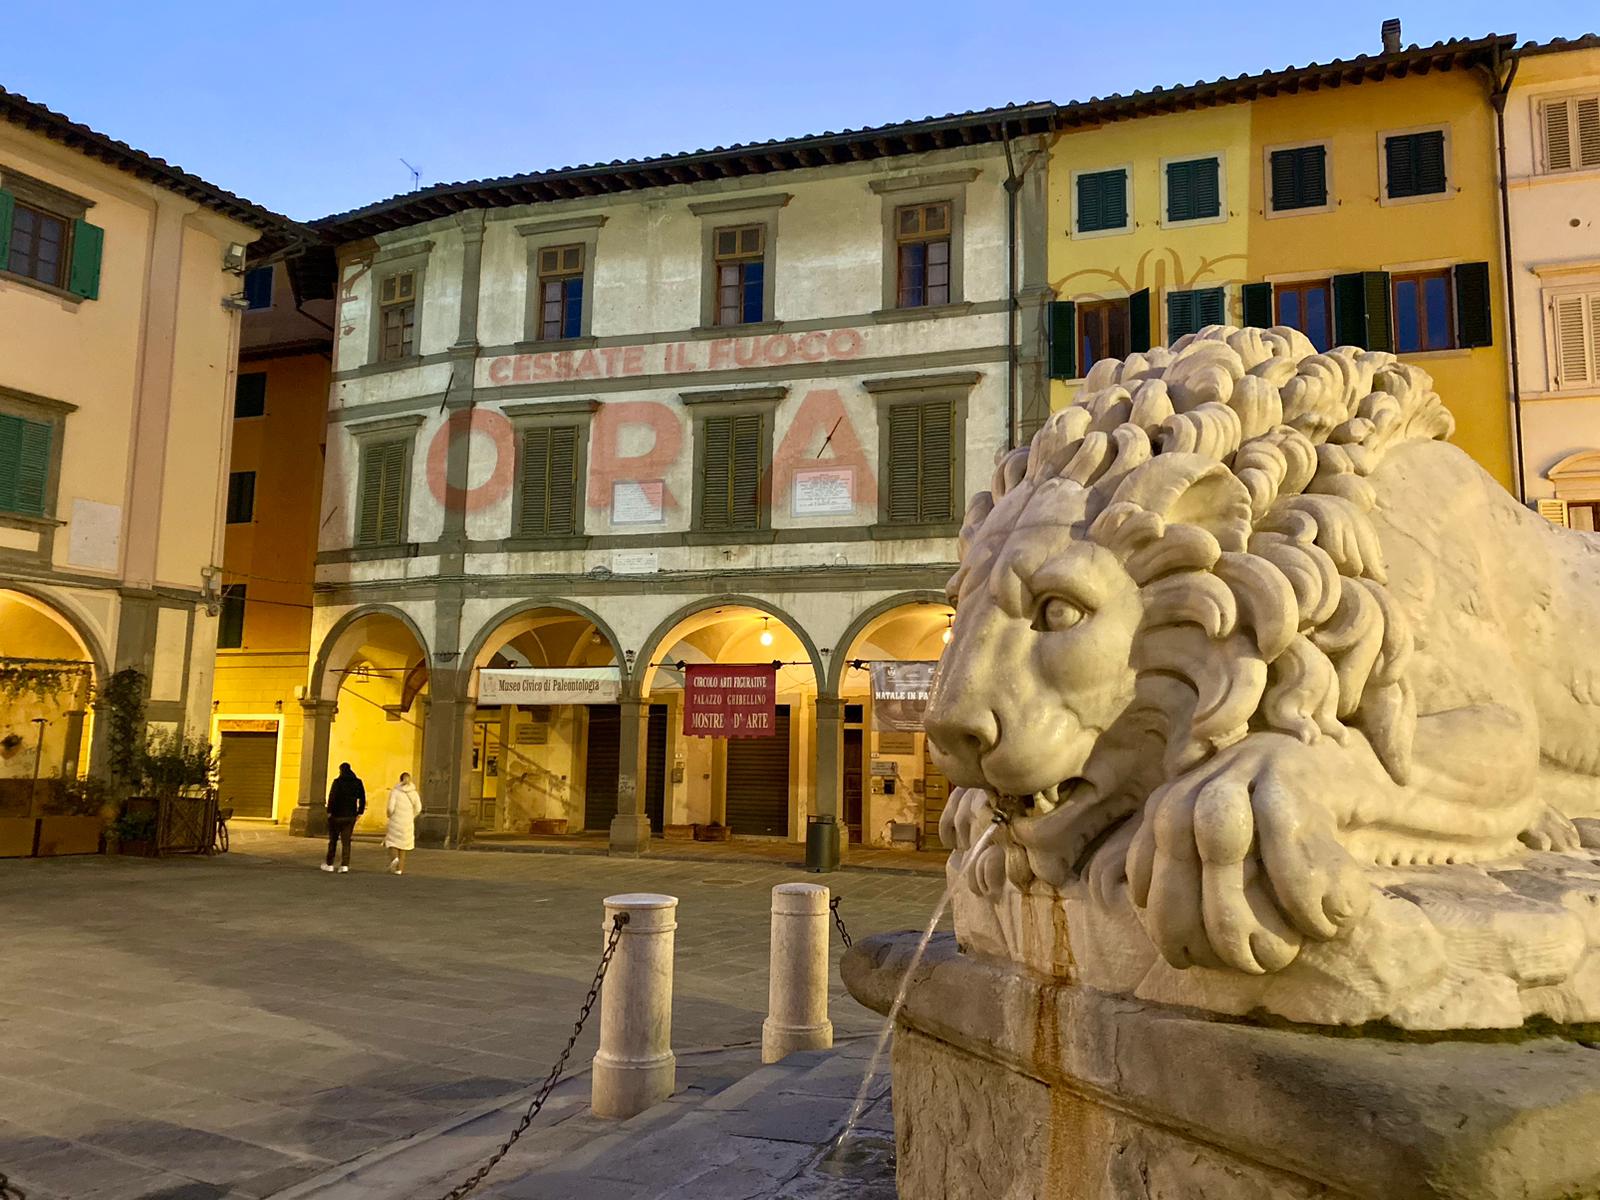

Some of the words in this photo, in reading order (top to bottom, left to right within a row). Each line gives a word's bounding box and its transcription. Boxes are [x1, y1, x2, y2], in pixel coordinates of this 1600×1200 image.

[489, 347, 645, 385] CESSATE
[664, 343, 696, 372] IL
[707, 328, 863, 370] FUOCO
[426, 388, 878, 517] ORA
[498, 679, 520, 692] Museo
[521, 679, 542, 692] Civico
[543, 679, 551, 692] di
[552, 678, 600, 693] Paleontologia
[693, 676, 718, 688] CIRCOLO
[720, 676, 732, 688] ARTI
[733, 676, 767, 688] FIGURATIVE
[693, 694, 722, 705] PALAZZO
[726, 694, 766, 705] GHIBELLINO
[875, 691, 906, 700] NATALE
[907, 691, 916, 700] IN
[918, 691, 929, 700] PA
[691, 712, 724, 729] MOSTRE
[745, 712, 769, 728] ARTE
